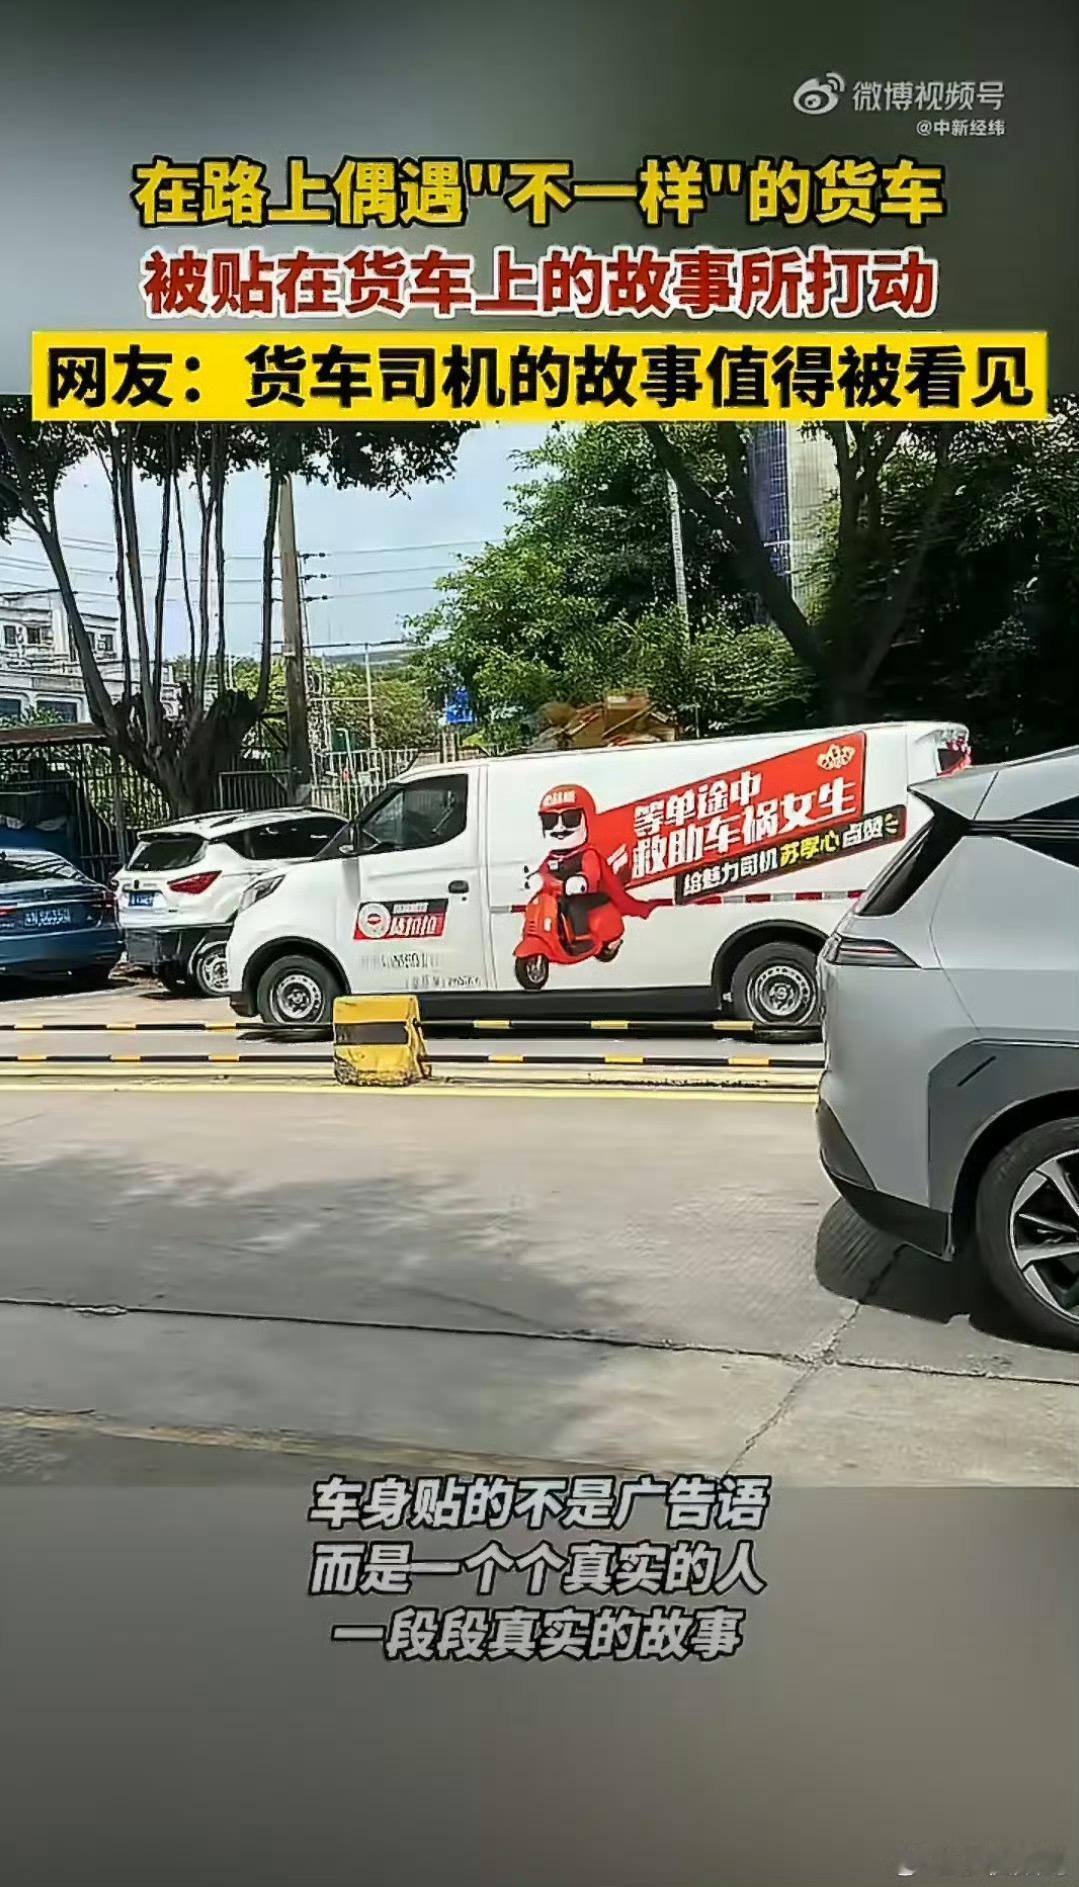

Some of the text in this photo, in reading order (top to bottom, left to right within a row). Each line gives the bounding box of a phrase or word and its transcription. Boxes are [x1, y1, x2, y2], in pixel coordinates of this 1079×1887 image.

[632, 776, 857, 879] 救助车祸女生
[634, 771, 762, 838] 等单途中
